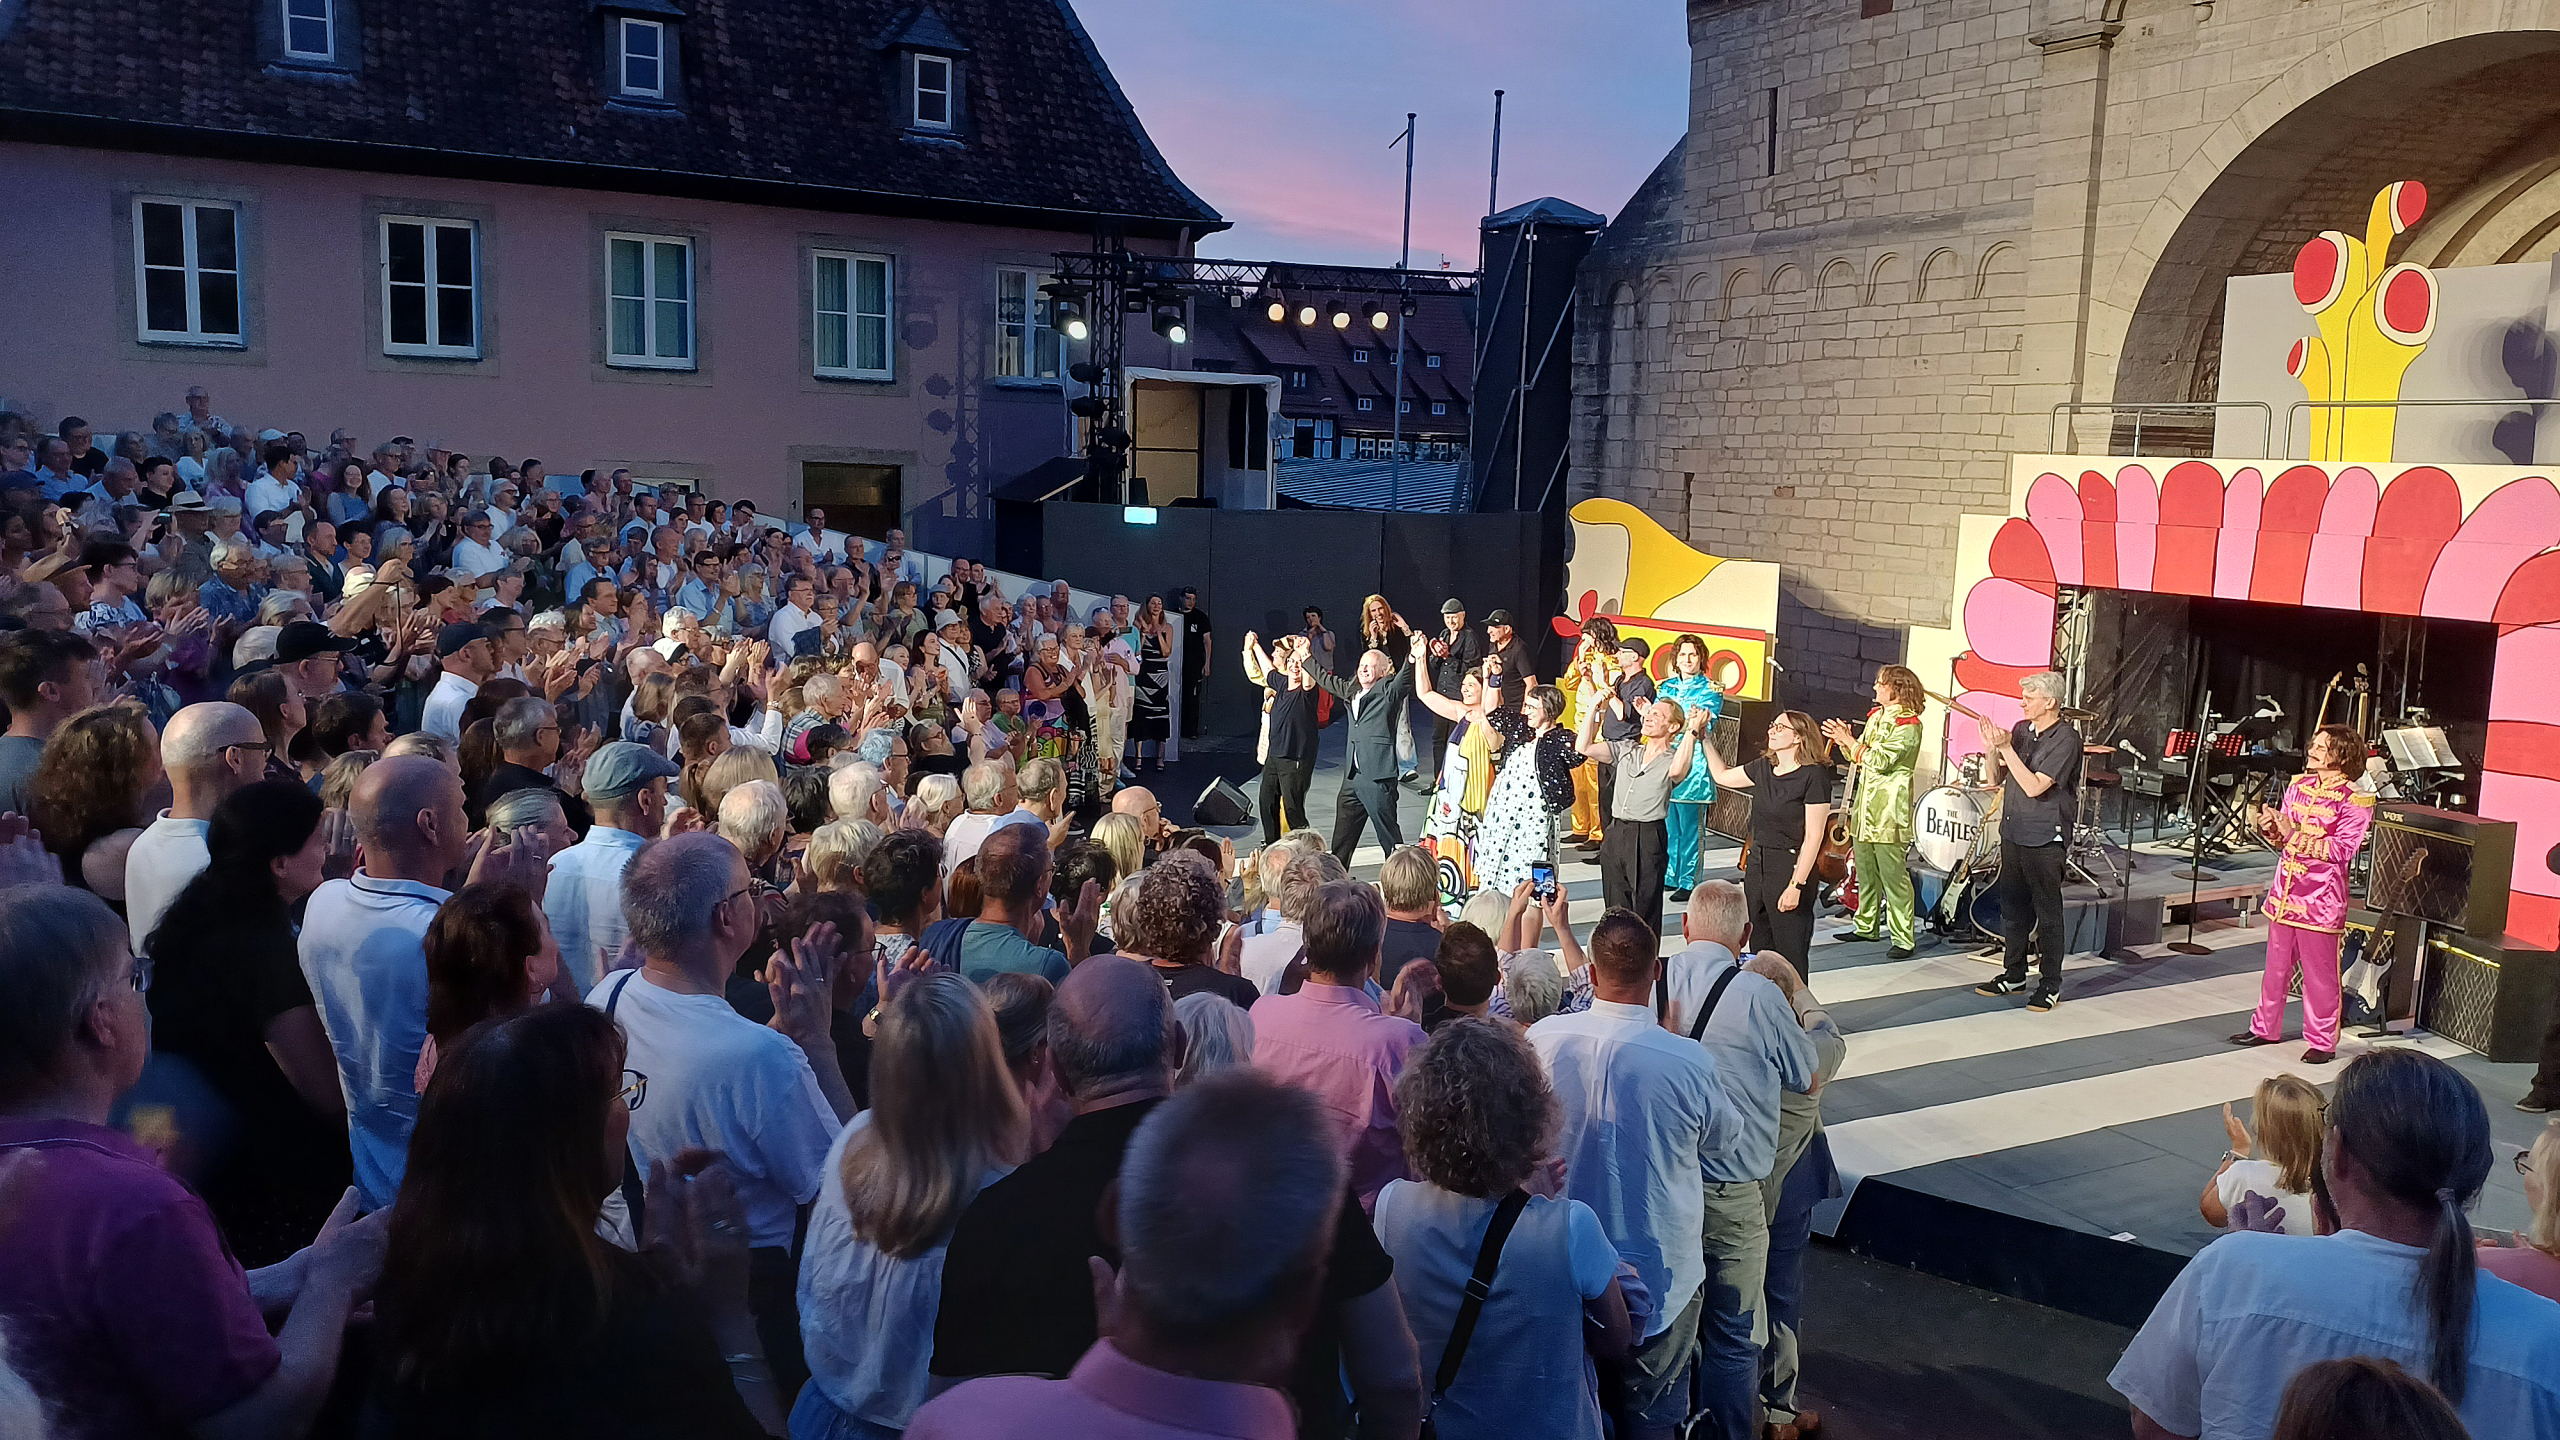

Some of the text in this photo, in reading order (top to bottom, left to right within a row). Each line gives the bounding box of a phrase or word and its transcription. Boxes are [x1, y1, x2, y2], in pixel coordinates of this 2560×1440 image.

[1946, 809, 1959, 819] THE
[2382, 810, 2404, 823] VOX
[1926, 806, 1978, 843] BEATLES
